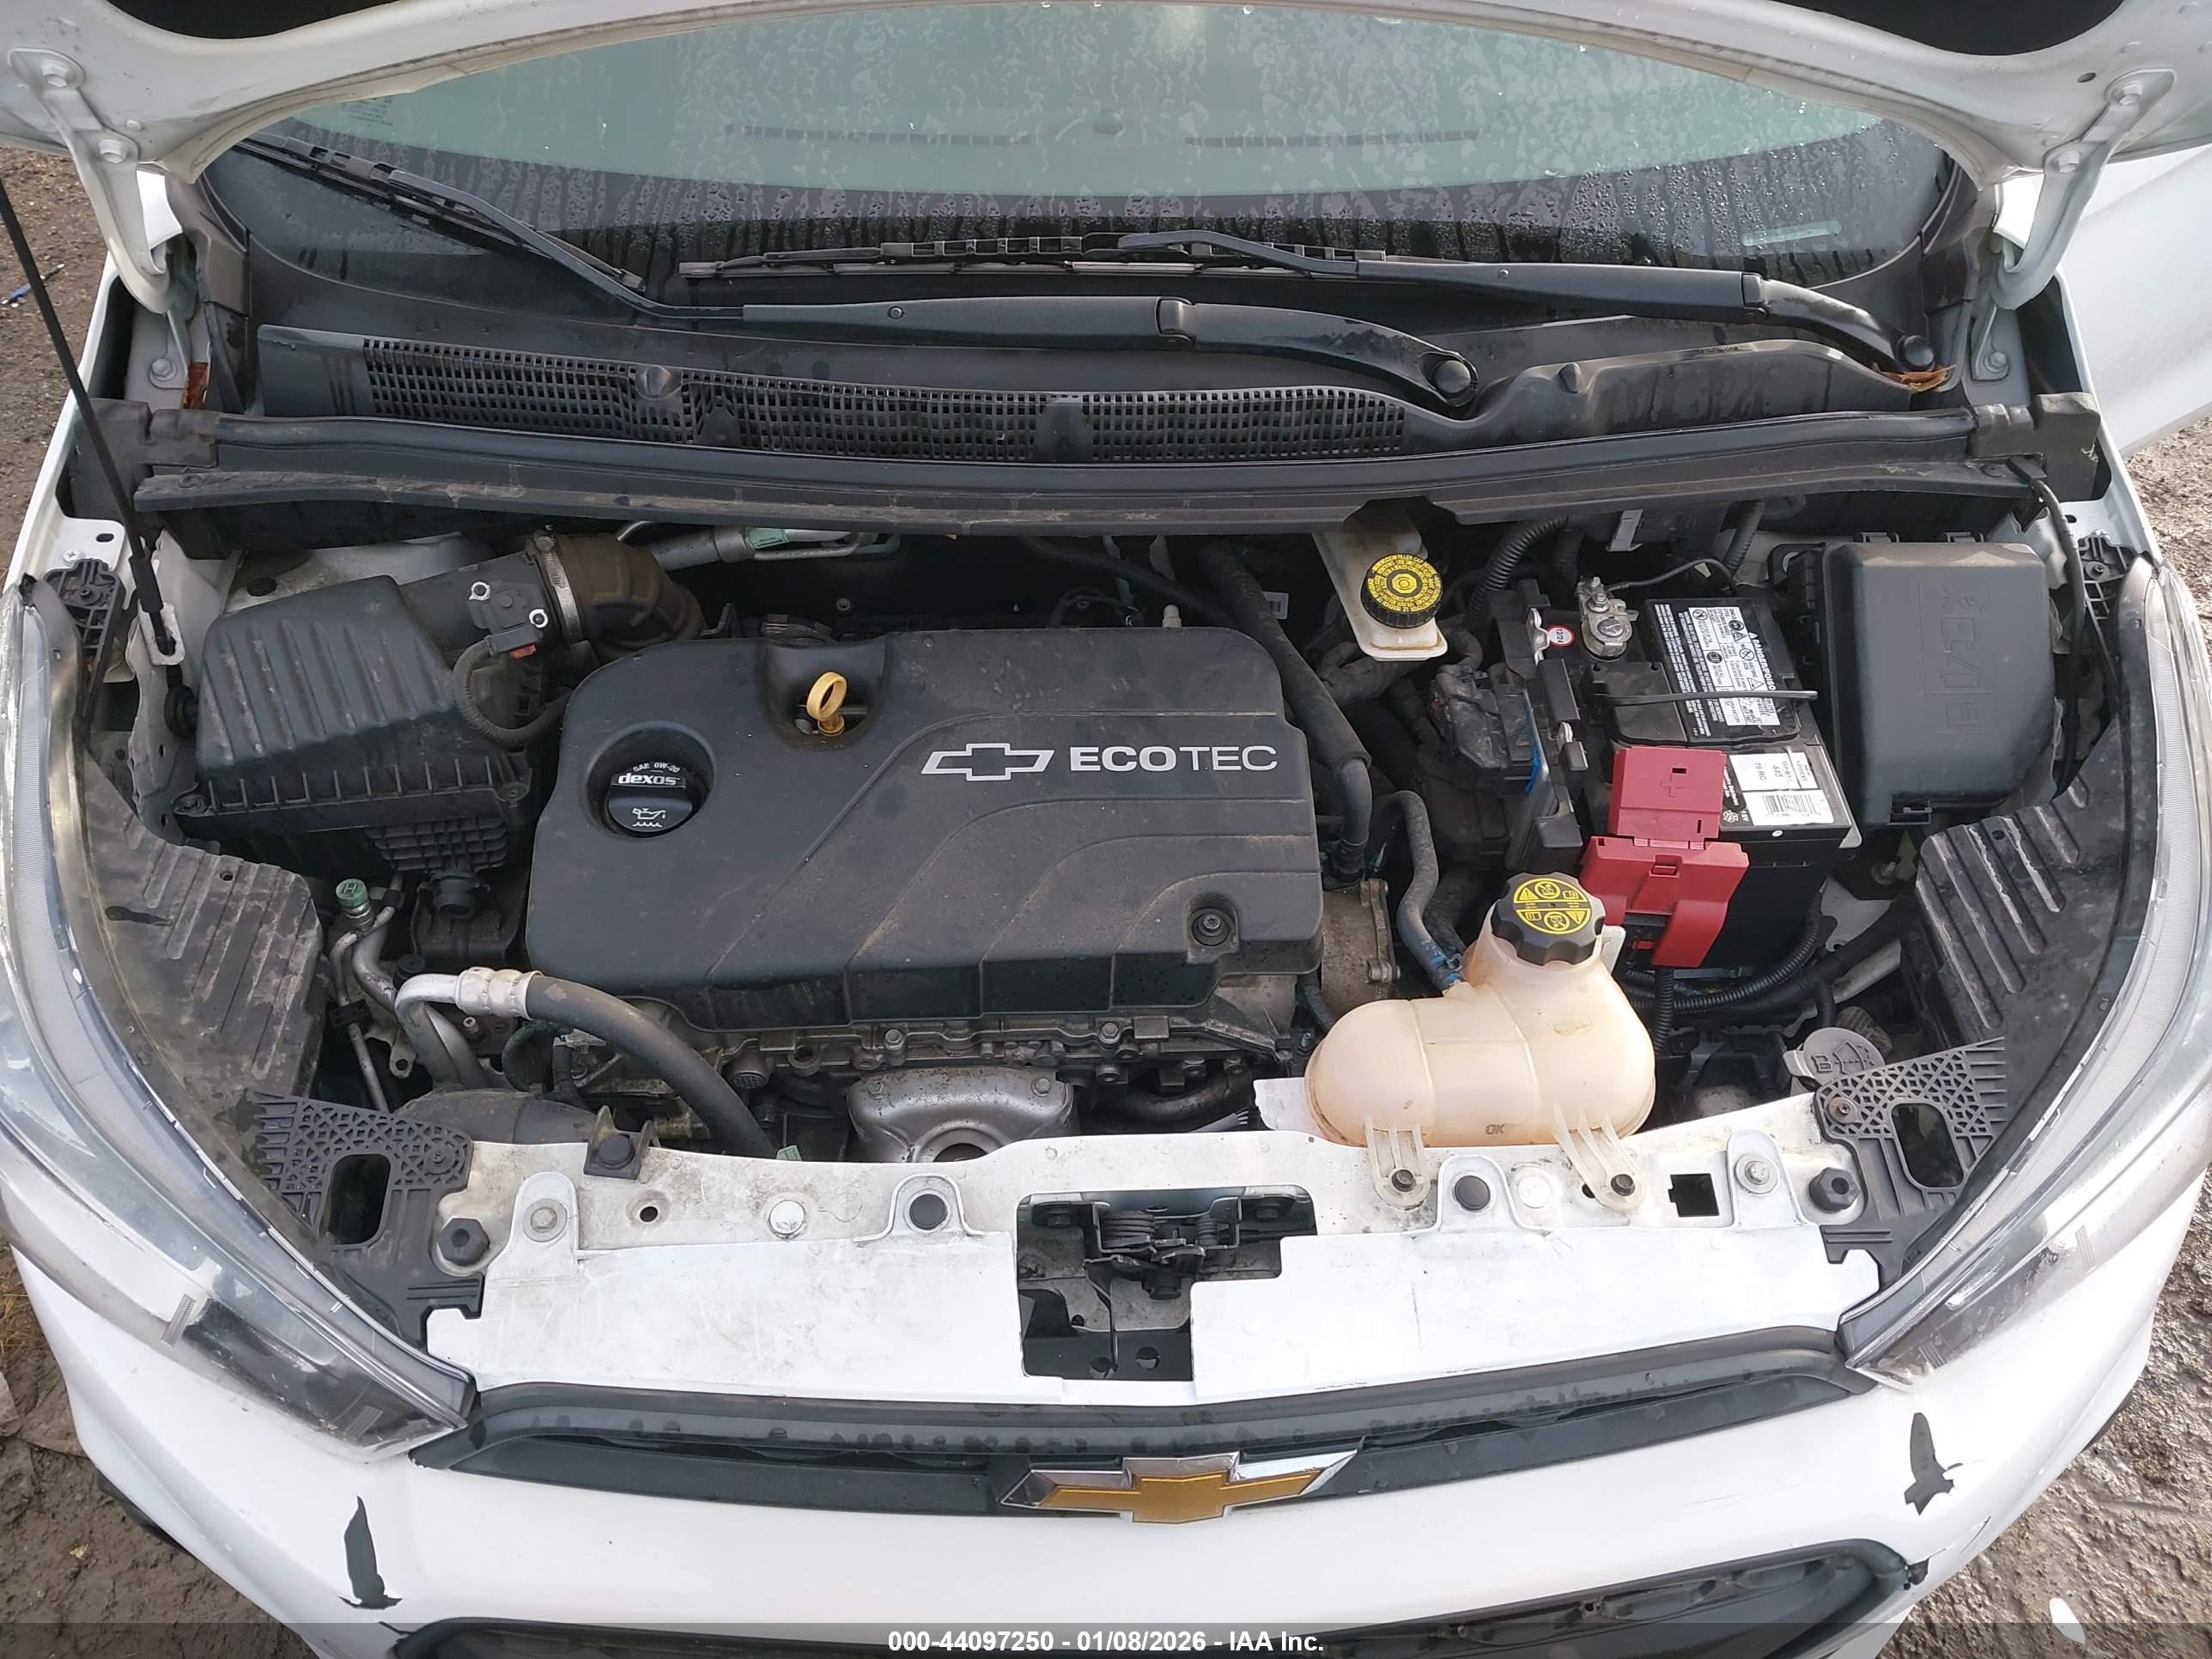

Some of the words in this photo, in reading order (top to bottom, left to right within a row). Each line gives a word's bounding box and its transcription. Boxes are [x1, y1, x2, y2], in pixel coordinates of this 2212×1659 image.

[1070, 745, 1279, 772] ECOTEC
[632, 763, 651, 773] SAE
[617, 773, 681, 786] dexos
